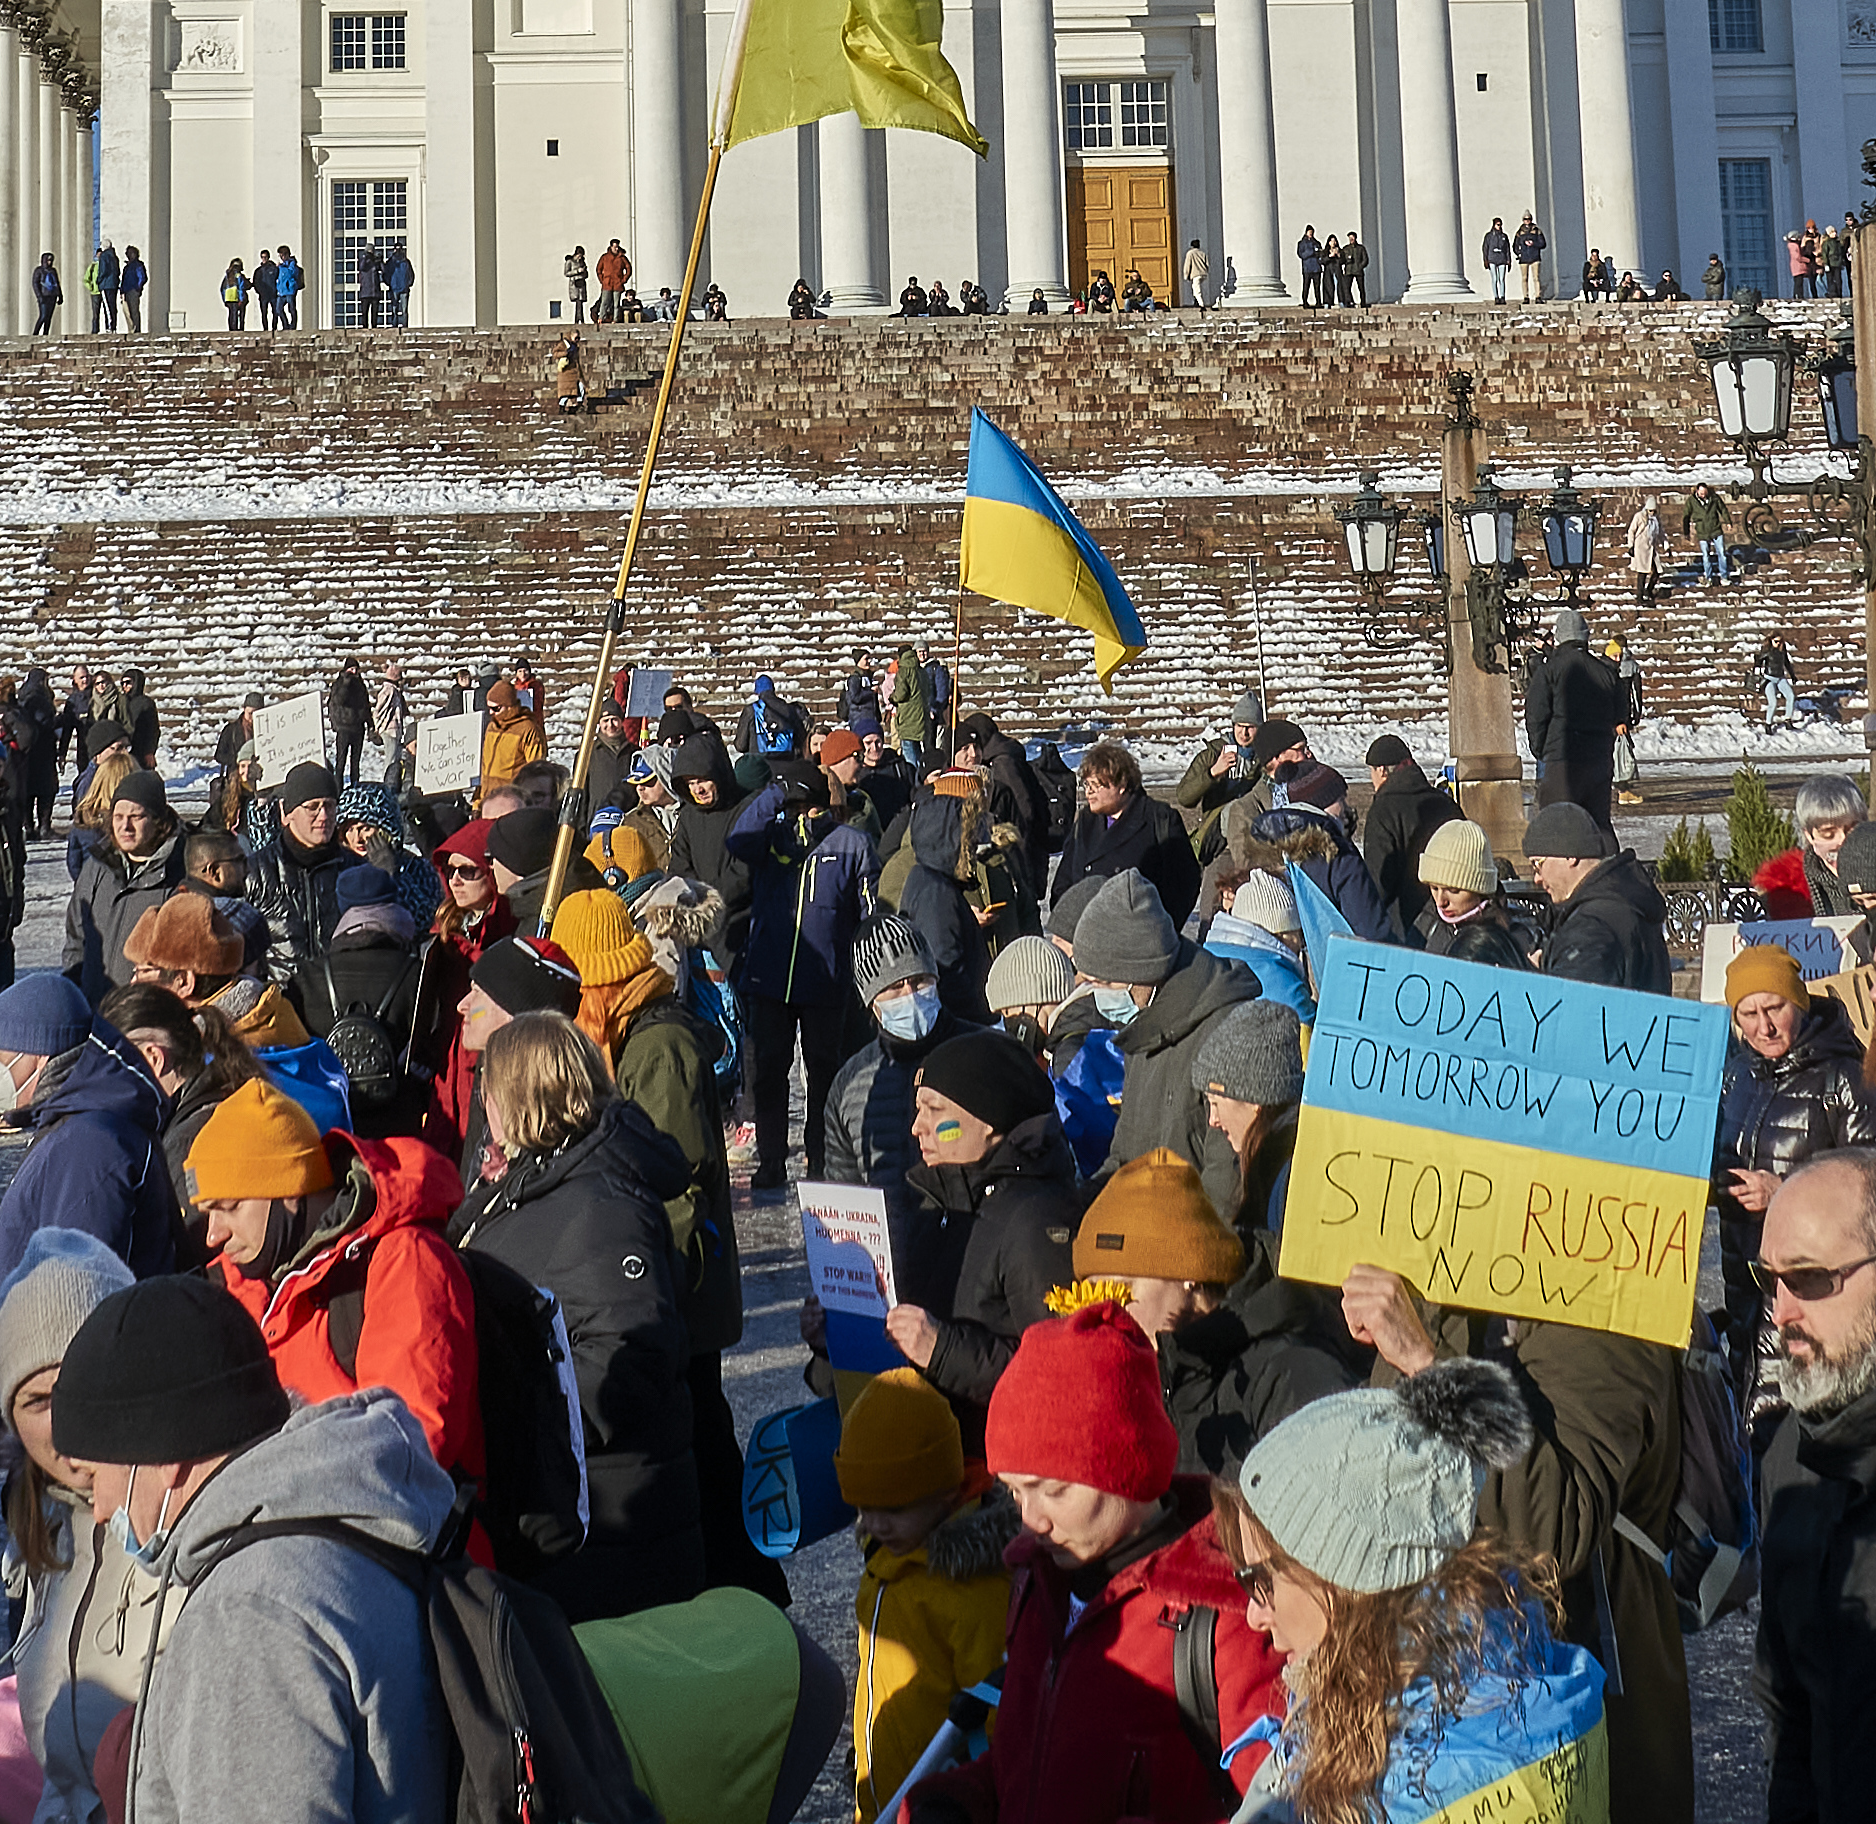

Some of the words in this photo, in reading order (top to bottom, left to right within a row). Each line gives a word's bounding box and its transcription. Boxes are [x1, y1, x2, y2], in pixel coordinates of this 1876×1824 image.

[256, 712, 270, 738] It
[276, 714, 287, 729] is
[291, 704, 307, 723] not
[427, 727, 468, 760] Together
[438, 756, 454, 770] can
[457, 749, 476, 768] stop
[434, 769, 465, 788] war
[1347, 962, 1563, 1053] TODAY
[1601, 1005, 1701, 1076] WE
[1322, 1032, 1562, 1119] TOMORROW
[1588, 1079, 1686, 1142] YOU
[1320, 1150, 1493, 1248] STOP
[1521, 1181, 1689, 1285] RUSSIA
[824, 1266, 845, 1280] STOP
[1426, 1246, 1599, 1307] NOW
